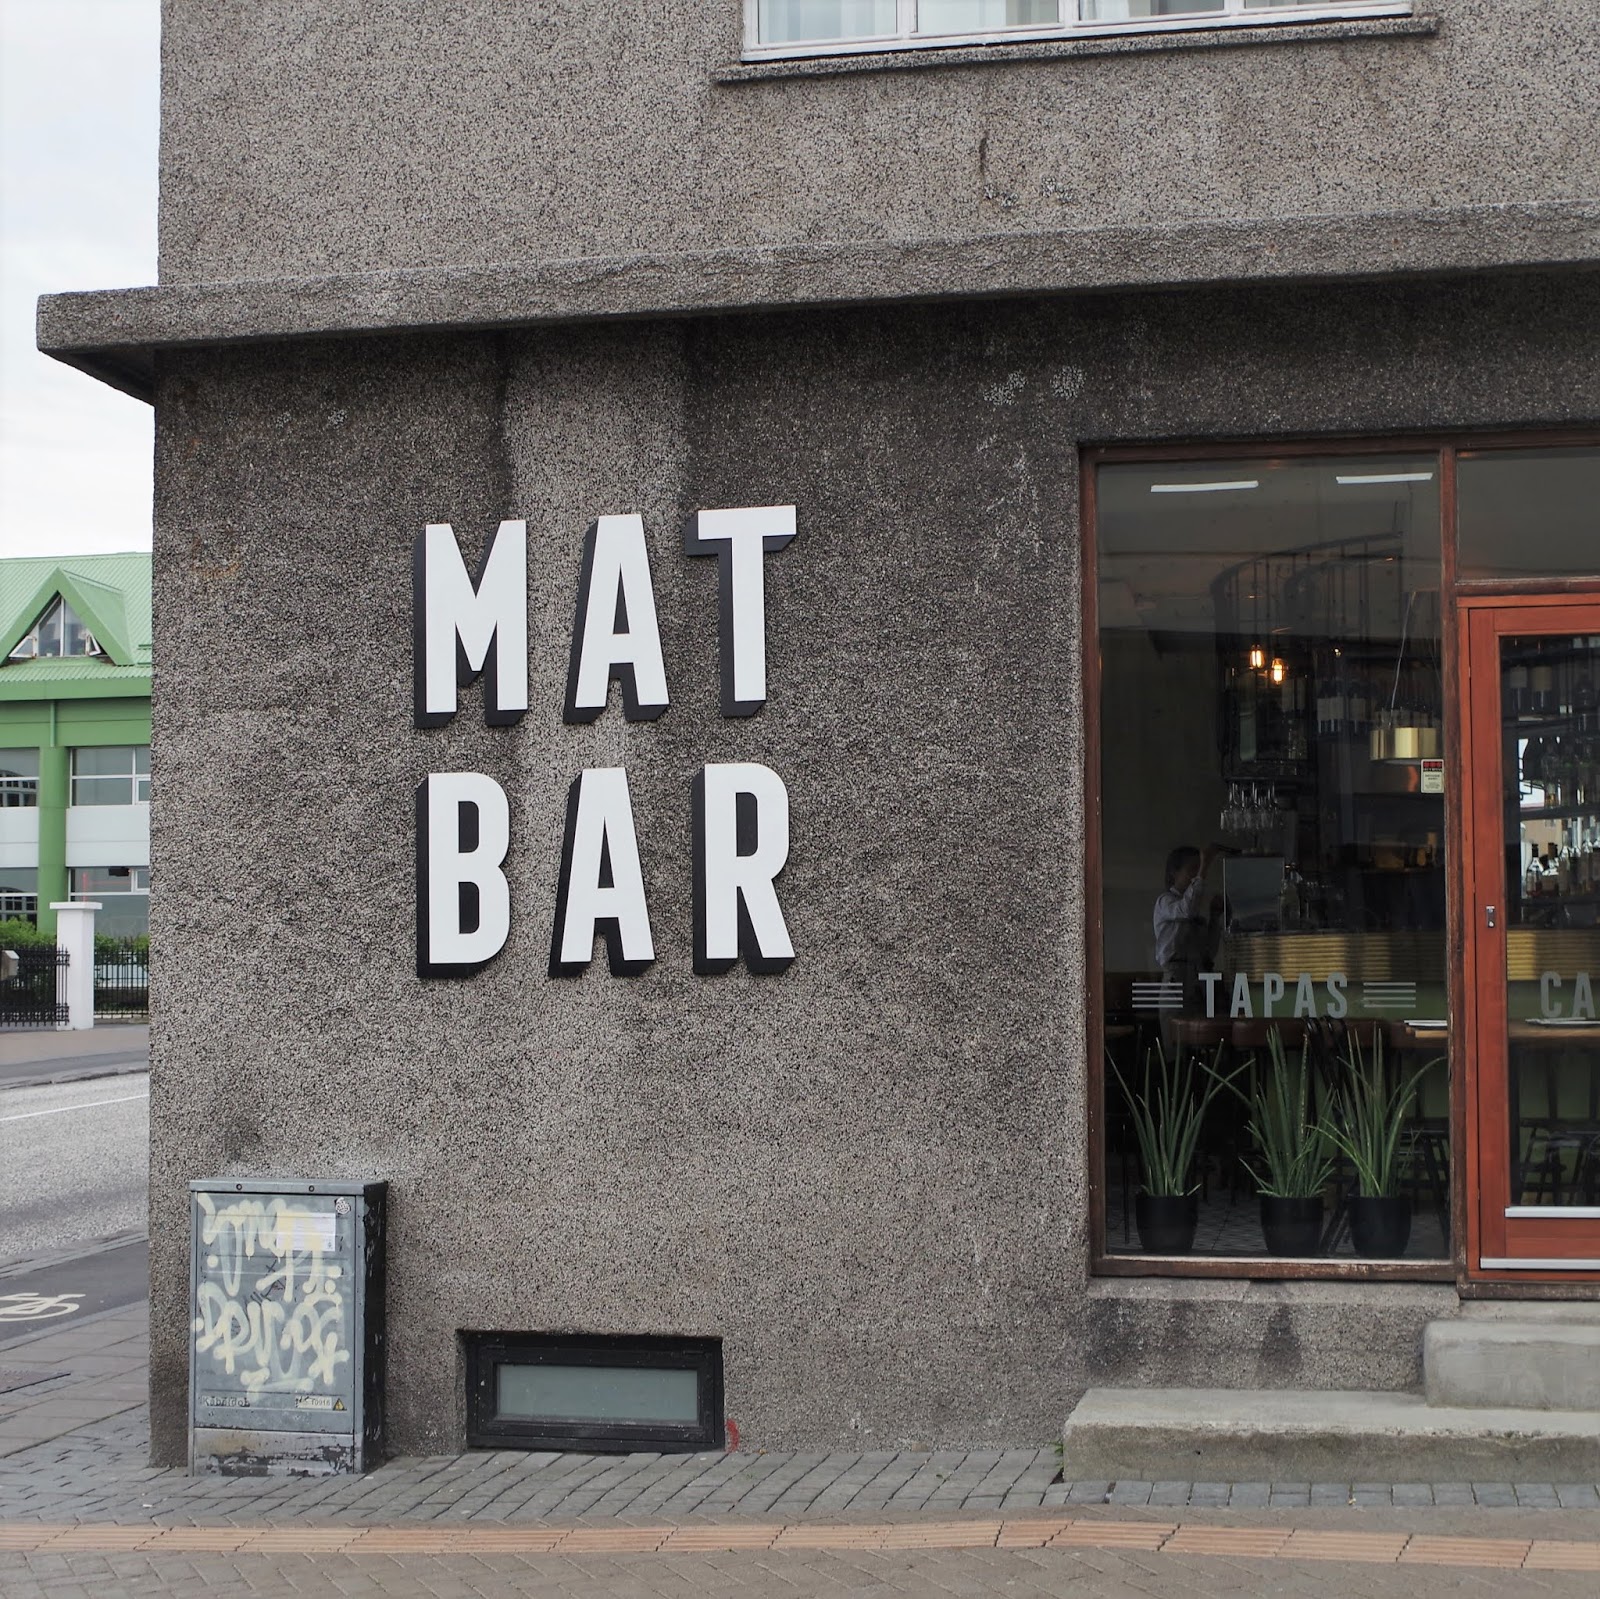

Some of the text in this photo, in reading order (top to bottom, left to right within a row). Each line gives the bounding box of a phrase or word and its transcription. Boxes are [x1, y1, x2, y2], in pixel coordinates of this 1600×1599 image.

[424, 505, 797, 714] MAT
[427, 763, 797, 965] BAR
[1198, 971, 1348, 1019] TAPAS
[1540, 970, 1597, 1019] CA
